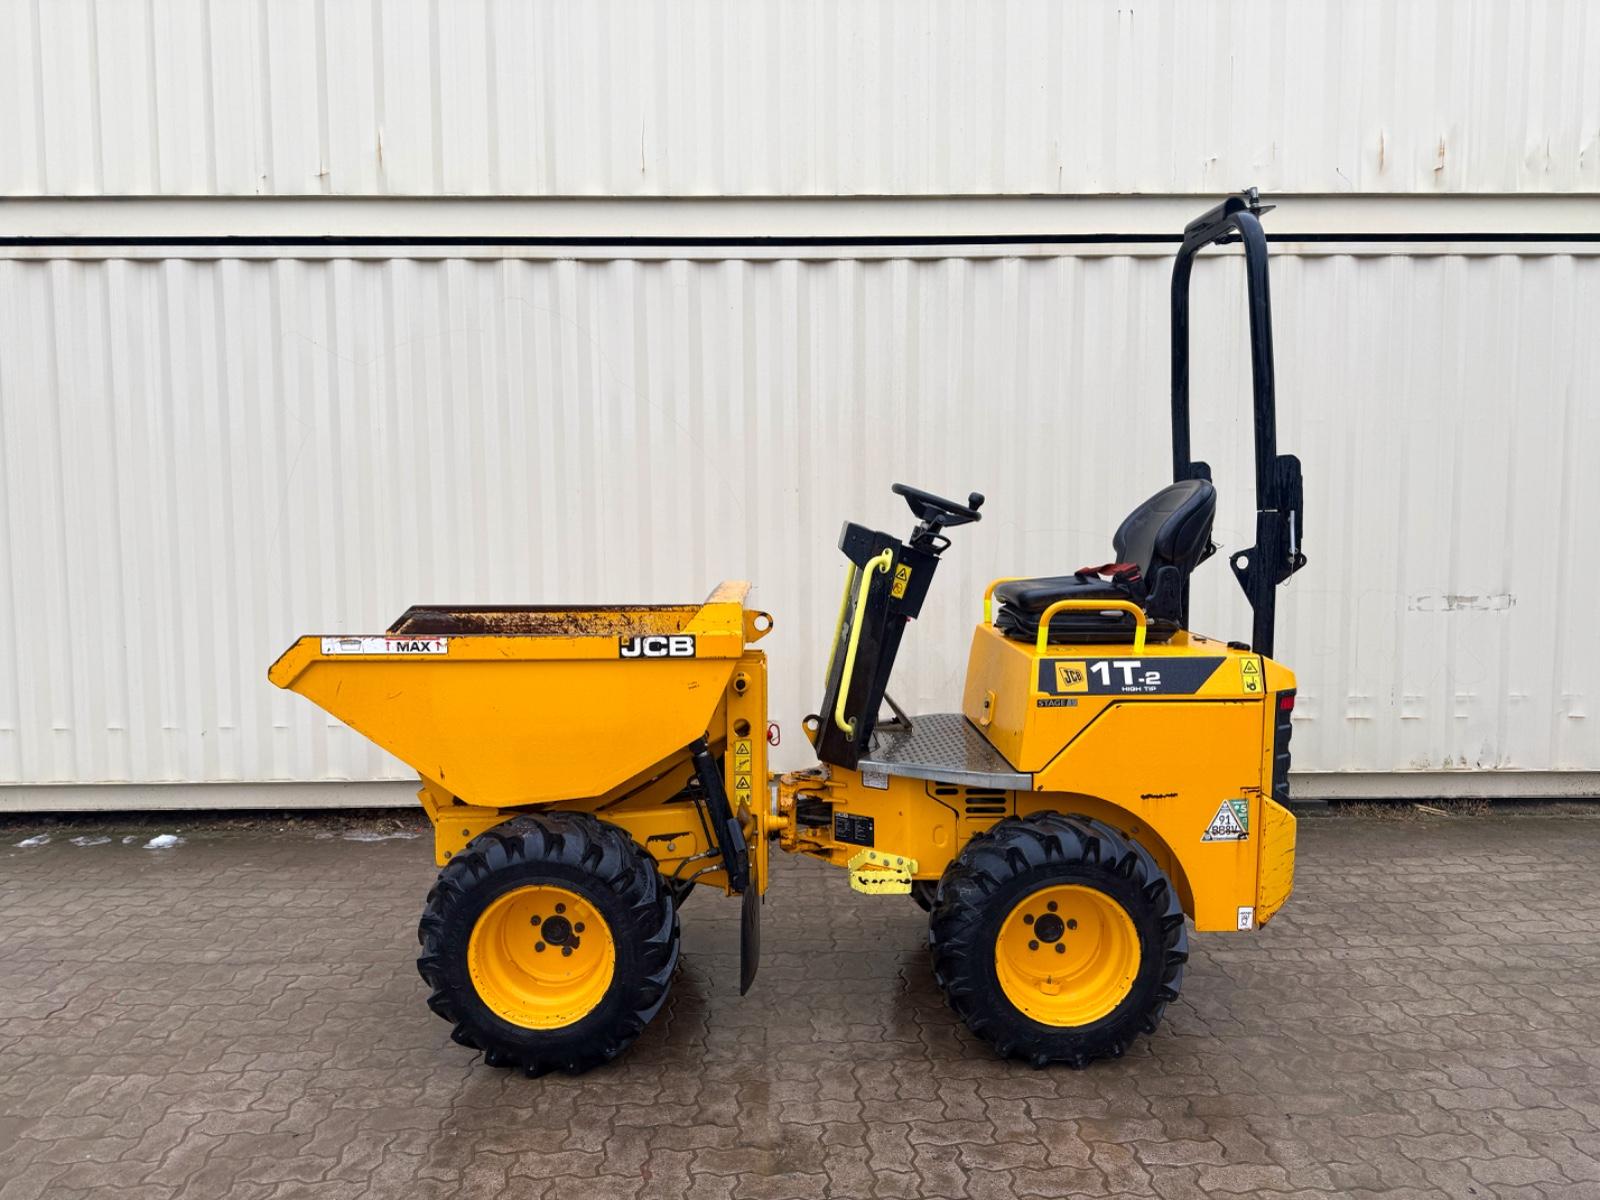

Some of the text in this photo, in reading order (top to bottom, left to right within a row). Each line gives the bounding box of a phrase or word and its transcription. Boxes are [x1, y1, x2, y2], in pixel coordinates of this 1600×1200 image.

[396, 641, 431, 652] MAX
[621, 636, 694, 657] JCB
[1062, 668, 1083, 685] JCB
[1090, 661, 1161, 685] 1T-2
[1037, 699, 1065, 707] STAGE
[1218, 814, 1230, 825] 91
